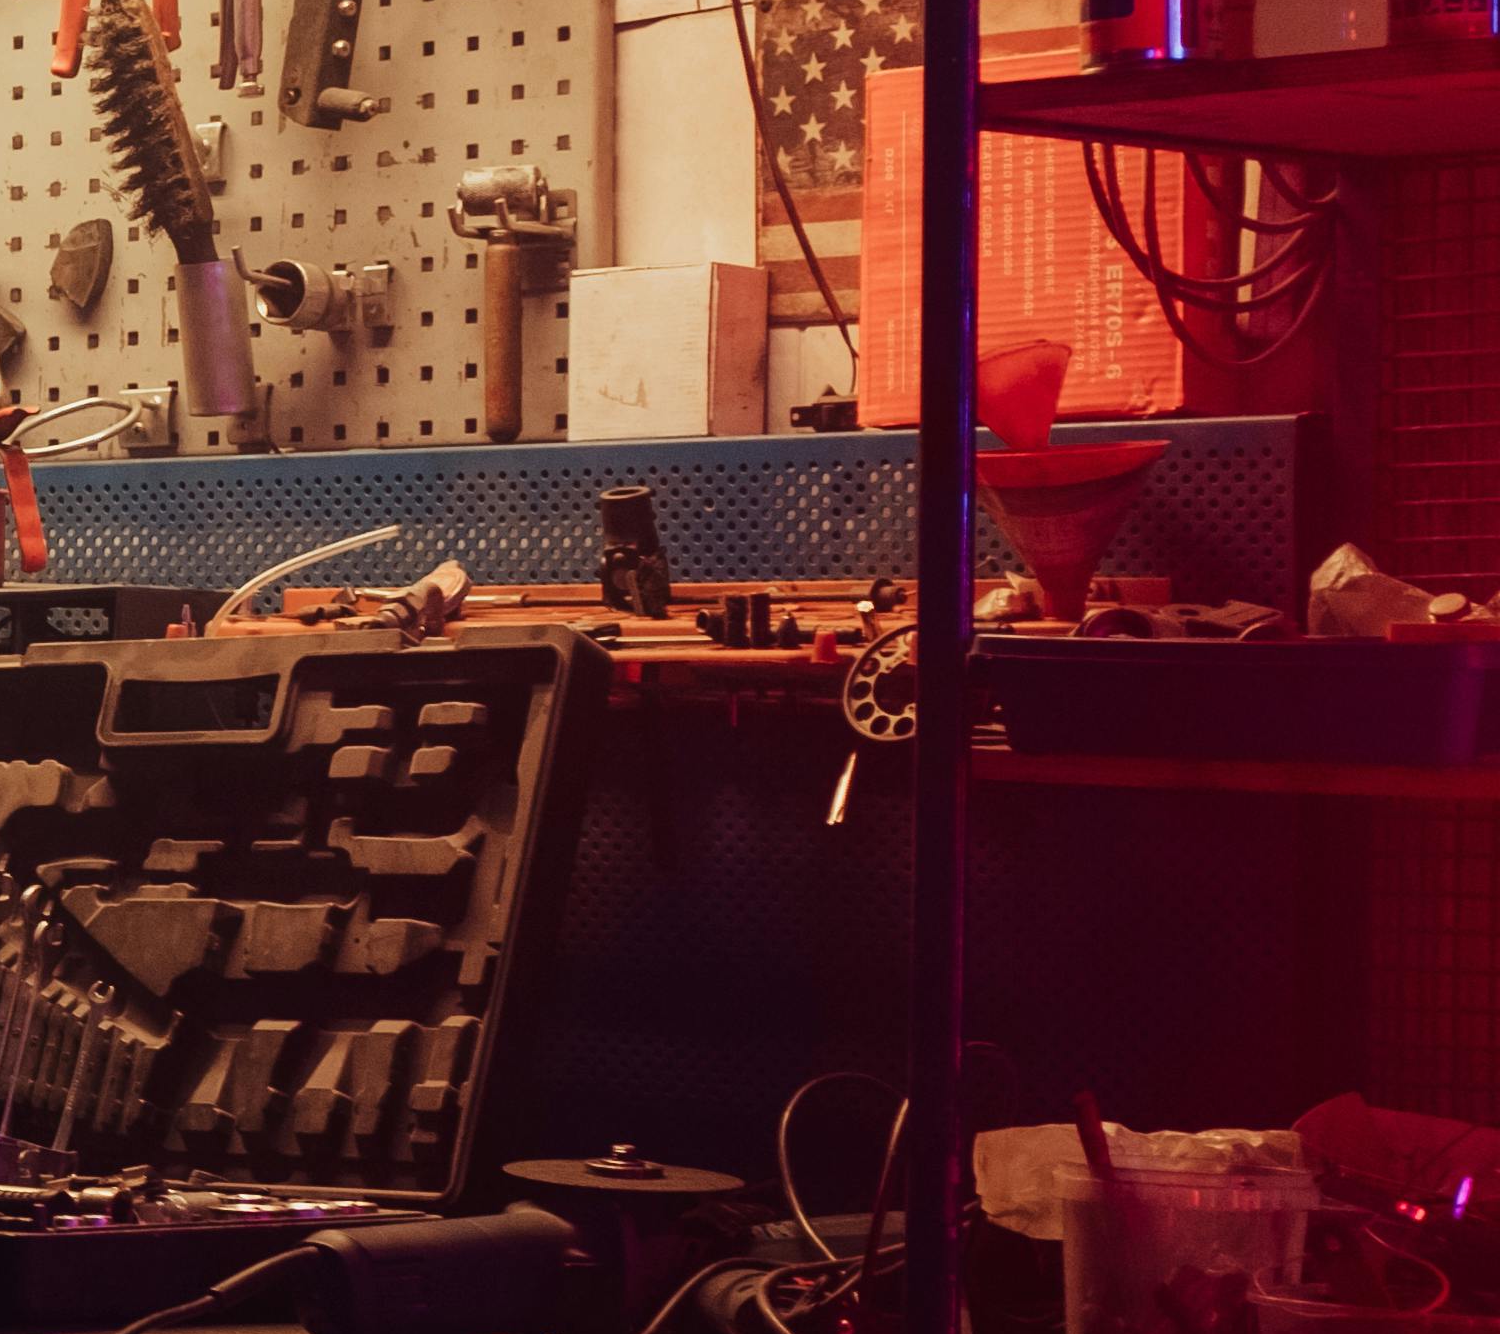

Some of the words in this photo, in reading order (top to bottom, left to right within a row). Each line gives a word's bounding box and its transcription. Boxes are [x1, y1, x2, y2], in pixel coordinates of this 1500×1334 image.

[982, 132, 992, 181] FICATED
[982, 185, 992, 201] BY
[1003, 183, 1013, 198] BY
